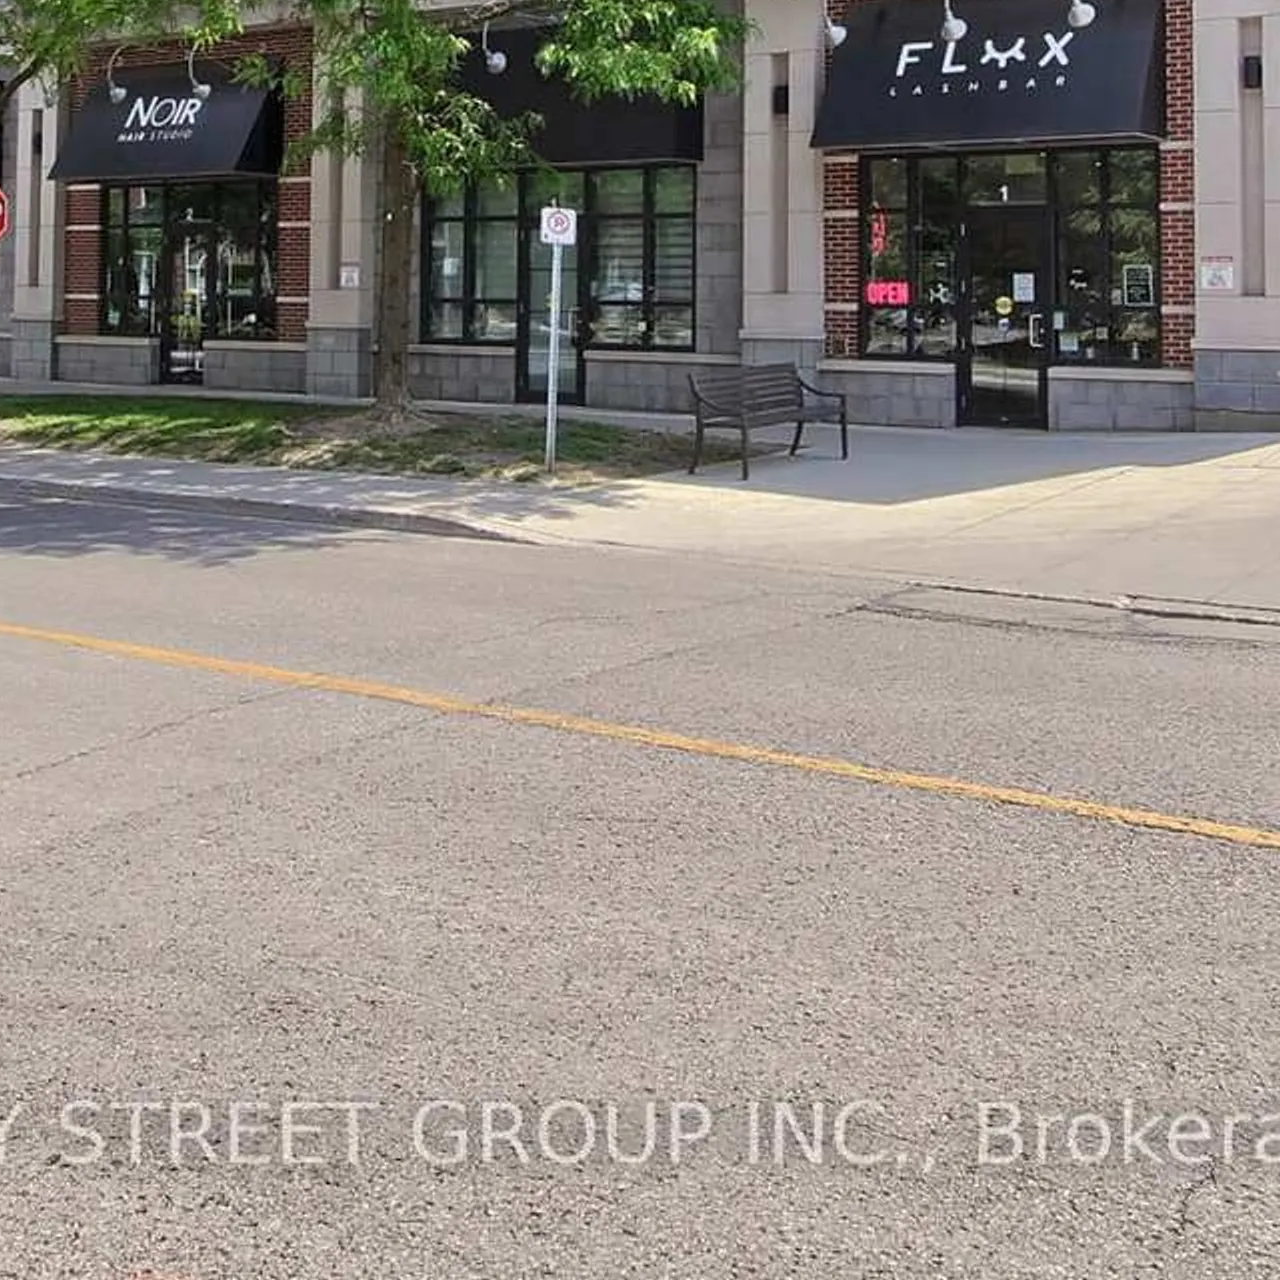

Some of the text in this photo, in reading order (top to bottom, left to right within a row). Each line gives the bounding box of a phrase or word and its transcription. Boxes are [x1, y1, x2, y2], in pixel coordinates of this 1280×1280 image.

[123, 95, 203, 129] NOIR
[117, 128, 194, 142] HAIR STUDIO
[998, 184, 1009, 203] 1
[866, 280, 910, 305] OPEN
